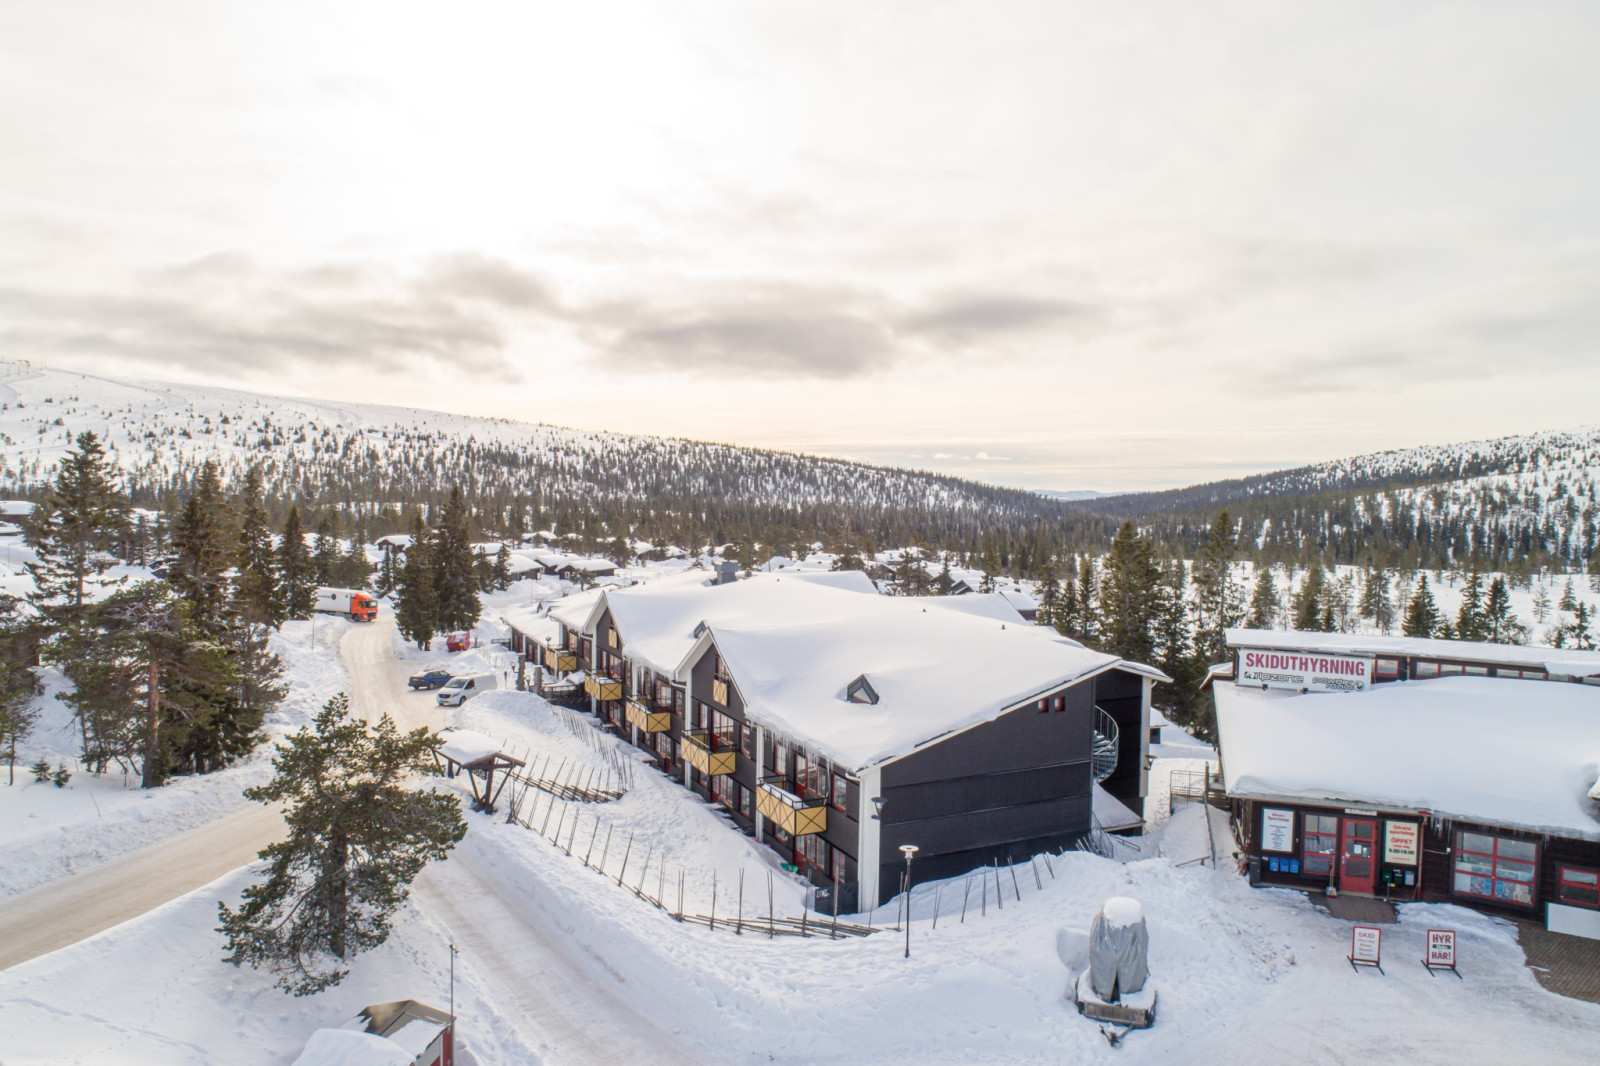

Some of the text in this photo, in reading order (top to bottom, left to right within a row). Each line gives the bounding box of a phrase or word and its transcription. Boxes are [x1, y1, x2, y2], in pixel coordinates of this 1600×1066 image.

[1245, 653, 1365, 676] SKIDUTHYRNING
[1391, 837, 1412, 845] ÖPPET
[1432, 934, 1451, 943] HYR
[1431, 949, 1451, 960] HÄR!
